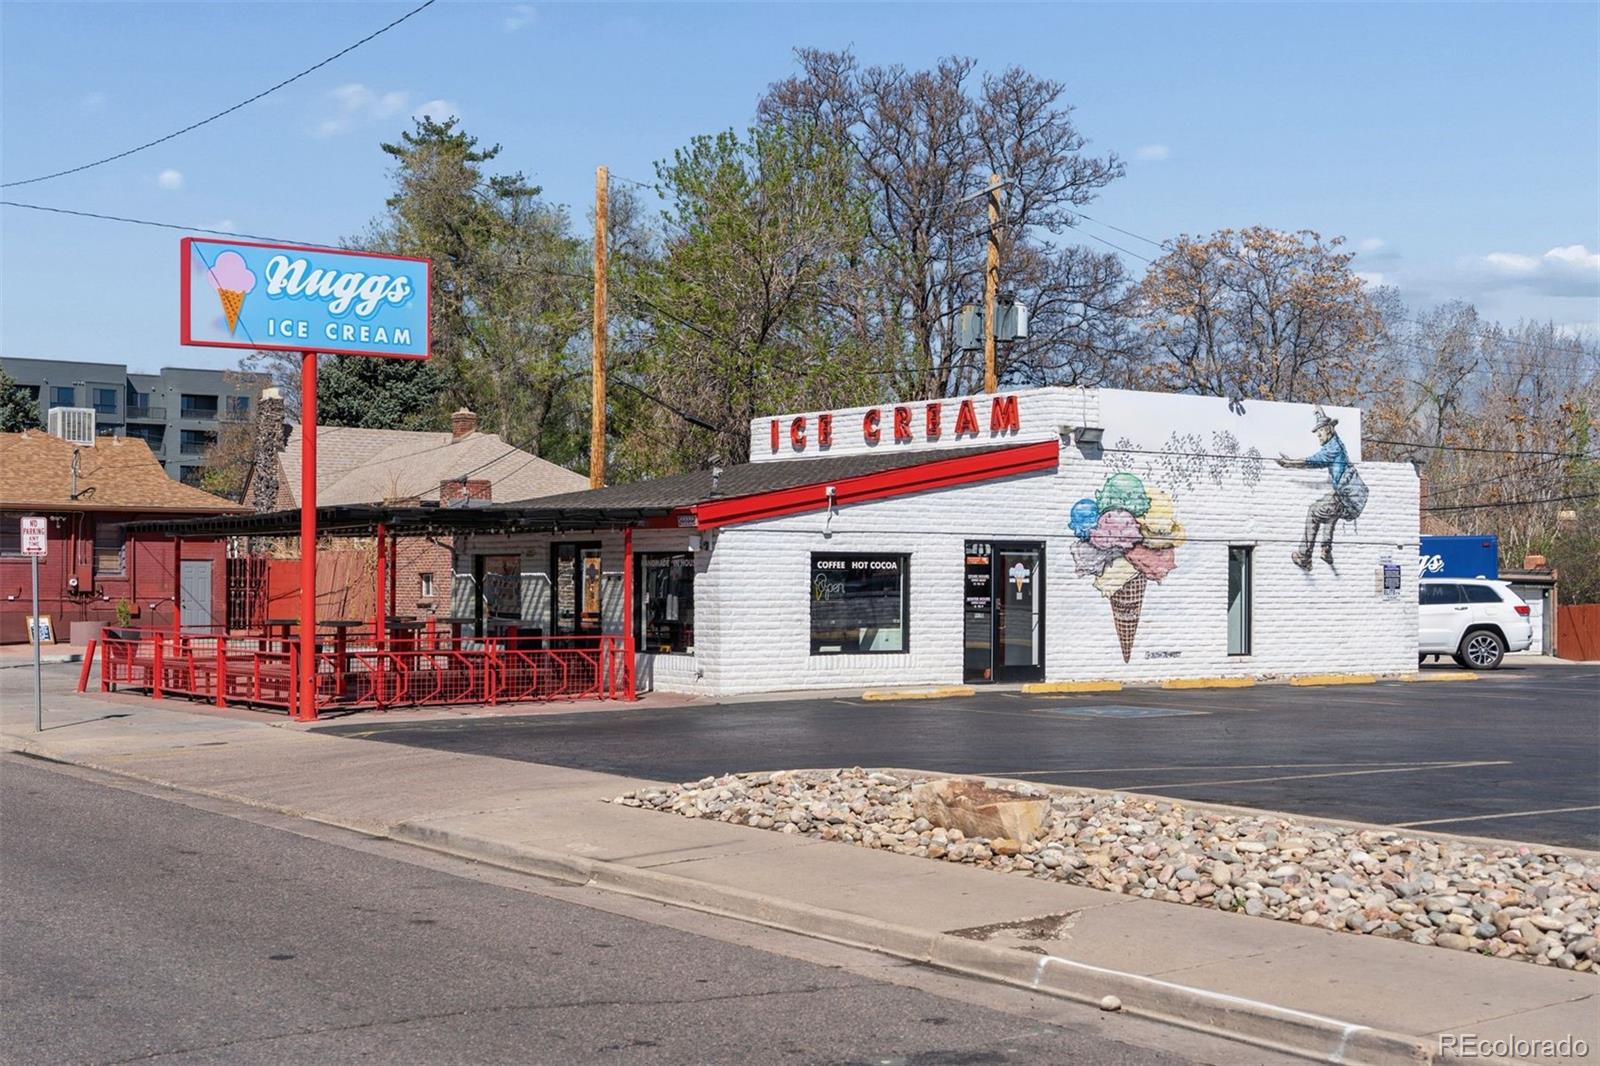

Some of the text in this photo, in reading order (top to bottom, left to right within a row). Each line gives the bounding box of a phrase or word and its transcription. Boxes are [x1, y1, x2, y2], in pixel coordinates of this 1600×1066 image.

[268, 319, 412, 345] ICE CREAM
[770, 395, 1020, 448] ICE CREAM
[29, 520, 38, 528] NO
[22, 528, 46, 536] PARKING
[817, 561, 898, 569] COFFEE HOT COCOA
